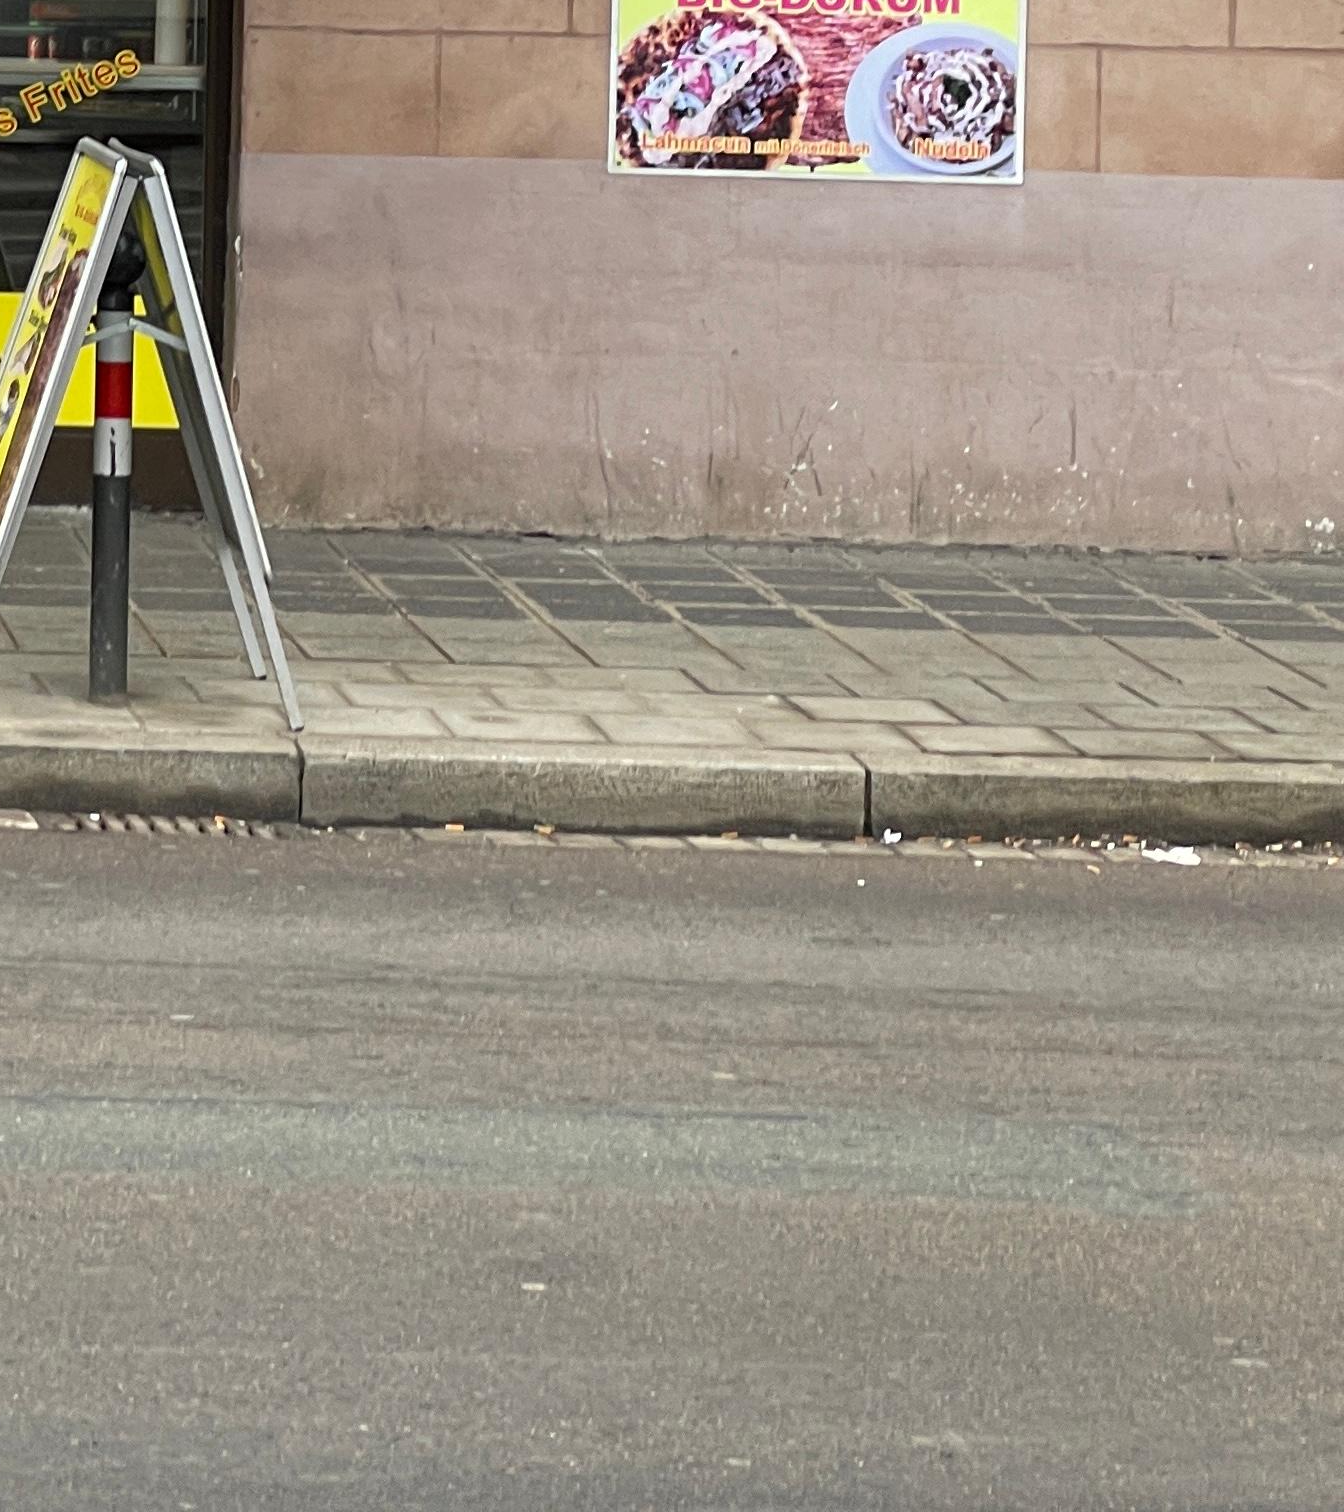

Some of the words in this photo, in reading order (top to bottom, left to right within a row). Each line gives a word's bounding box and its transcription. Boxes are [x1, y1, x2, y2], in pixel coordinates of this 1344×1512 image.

[20, 48, 142, 124] Frites
[642, 133, 750, 155] Lahmacun
[914, 137, 991, 159] Nudeln
